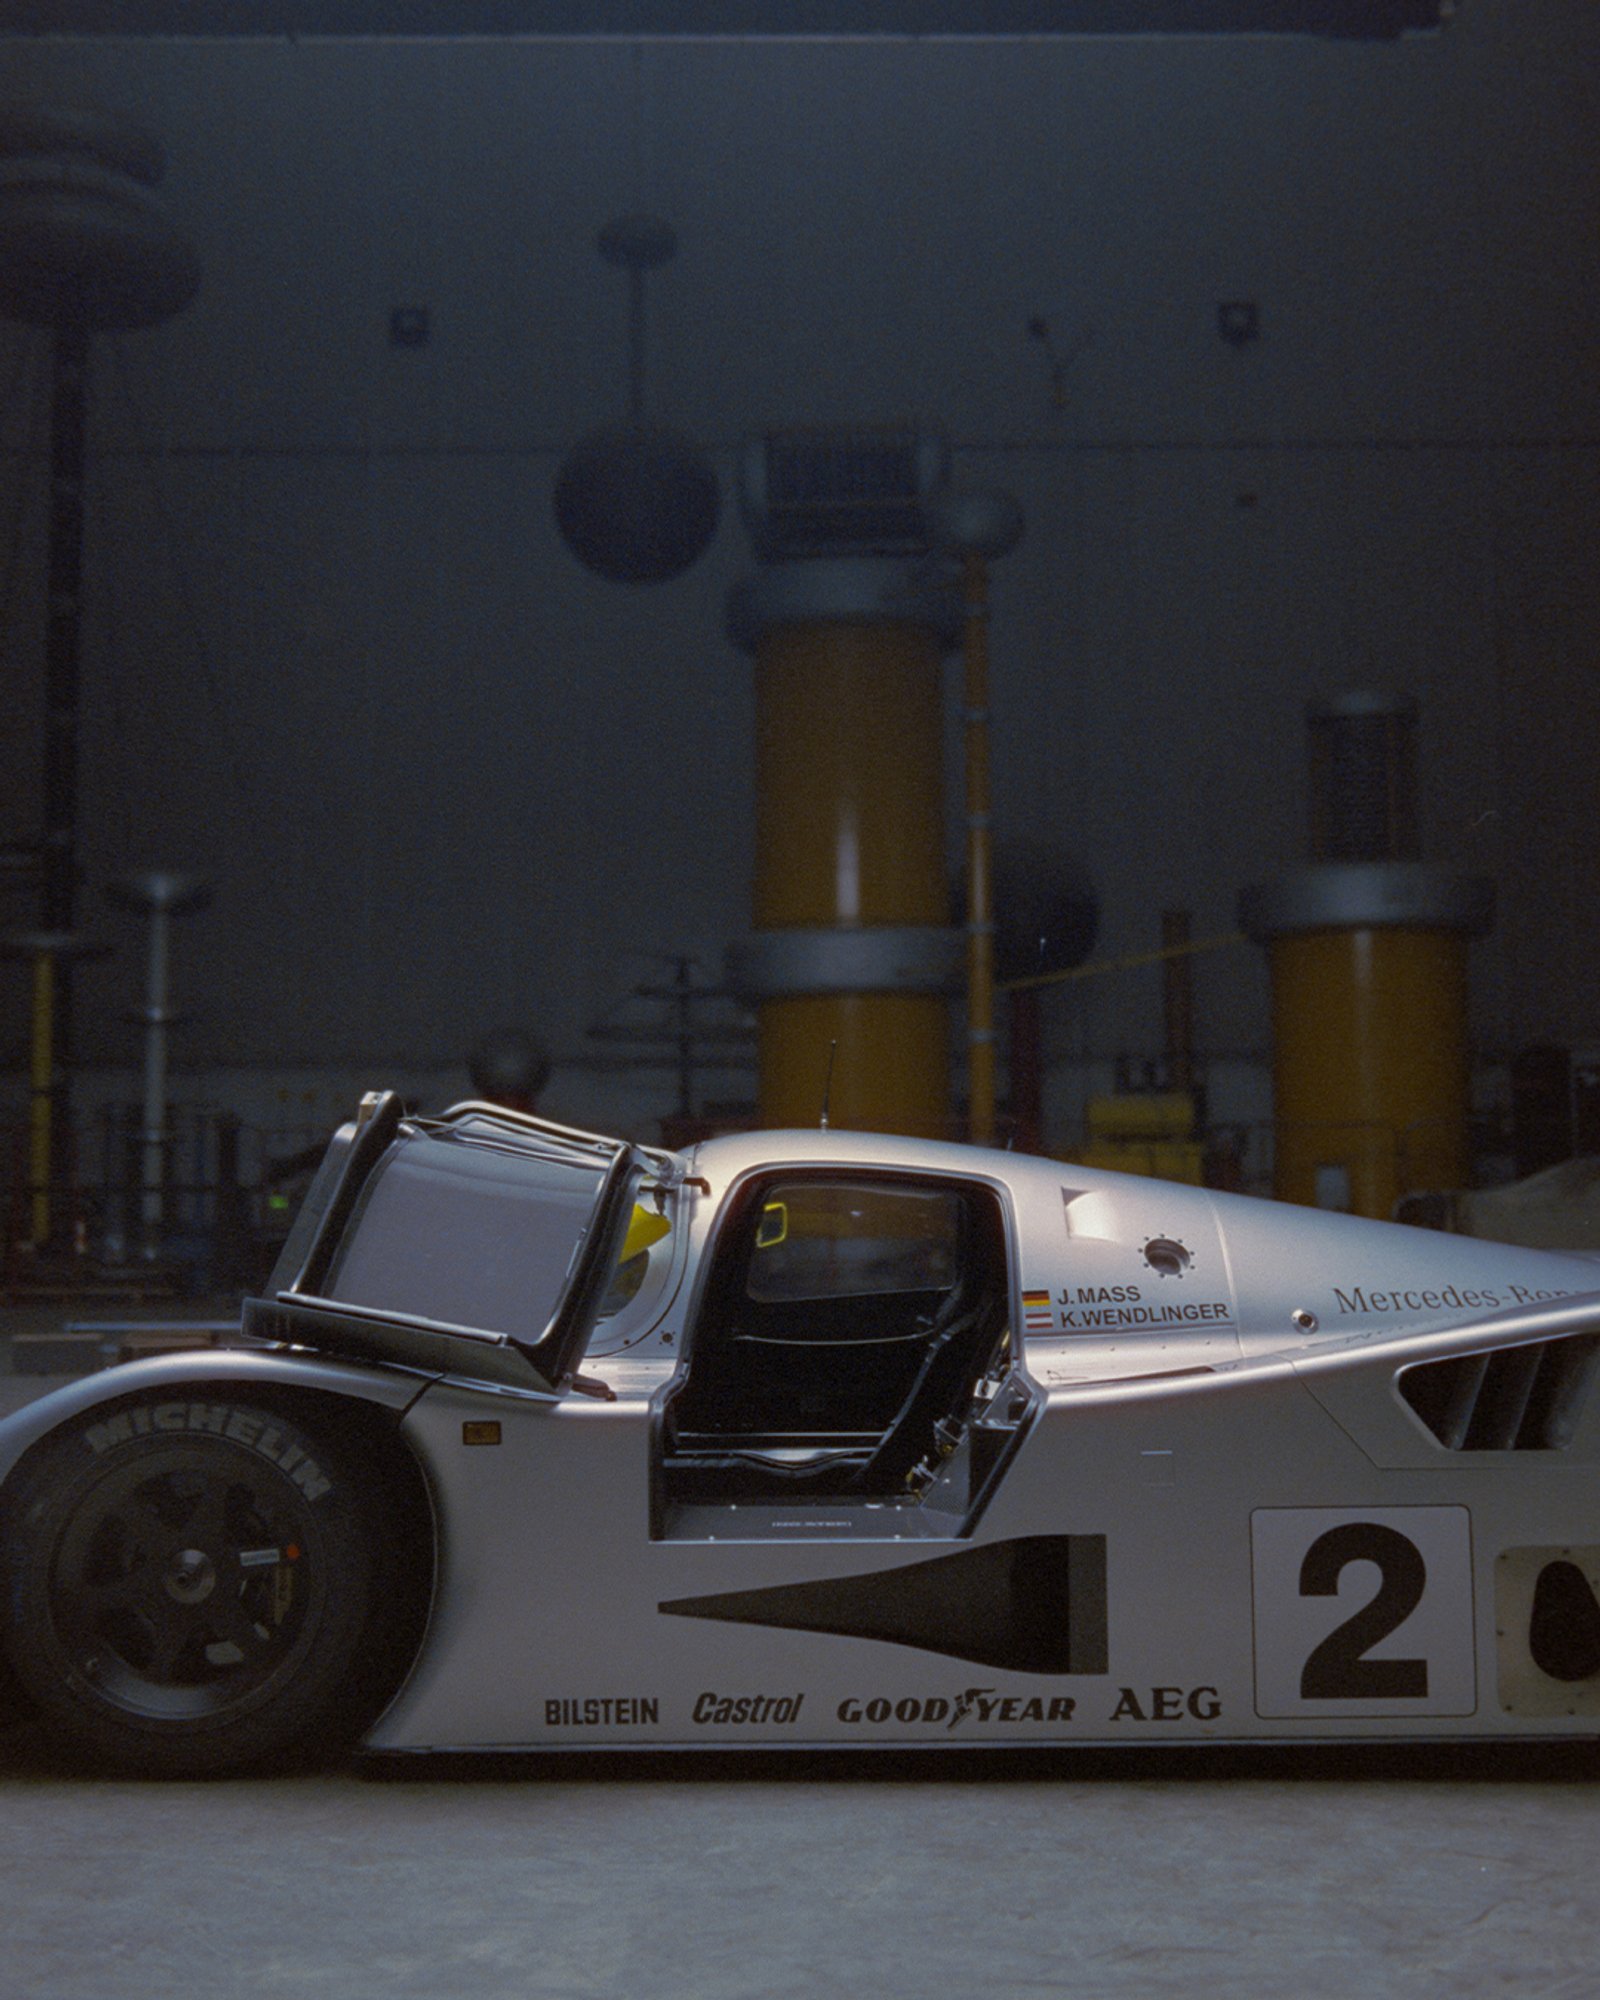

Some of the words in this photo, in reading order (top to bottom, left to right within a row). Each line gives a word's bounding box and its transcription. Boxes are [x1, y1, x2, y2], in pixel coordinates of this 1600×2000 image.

[1058, 1285, 1141, 1305] J.MASS
[1333, 1284, 1586, 1314] Mercedes-Be
[1061, 1303, 1229, 1328] K.WENDLINGER
[84, 1402, 332, 1501] MICHELIN
[1299, 1522, 1428, 1698] 2
[545, 1698, 659, 1725] BILSTEIN
[692, 1692, 805, 1724] Castrol
[836, 1694, 1076, 1724] GOODYEAR
[1109, 1686, 1222, 1721] AEG
